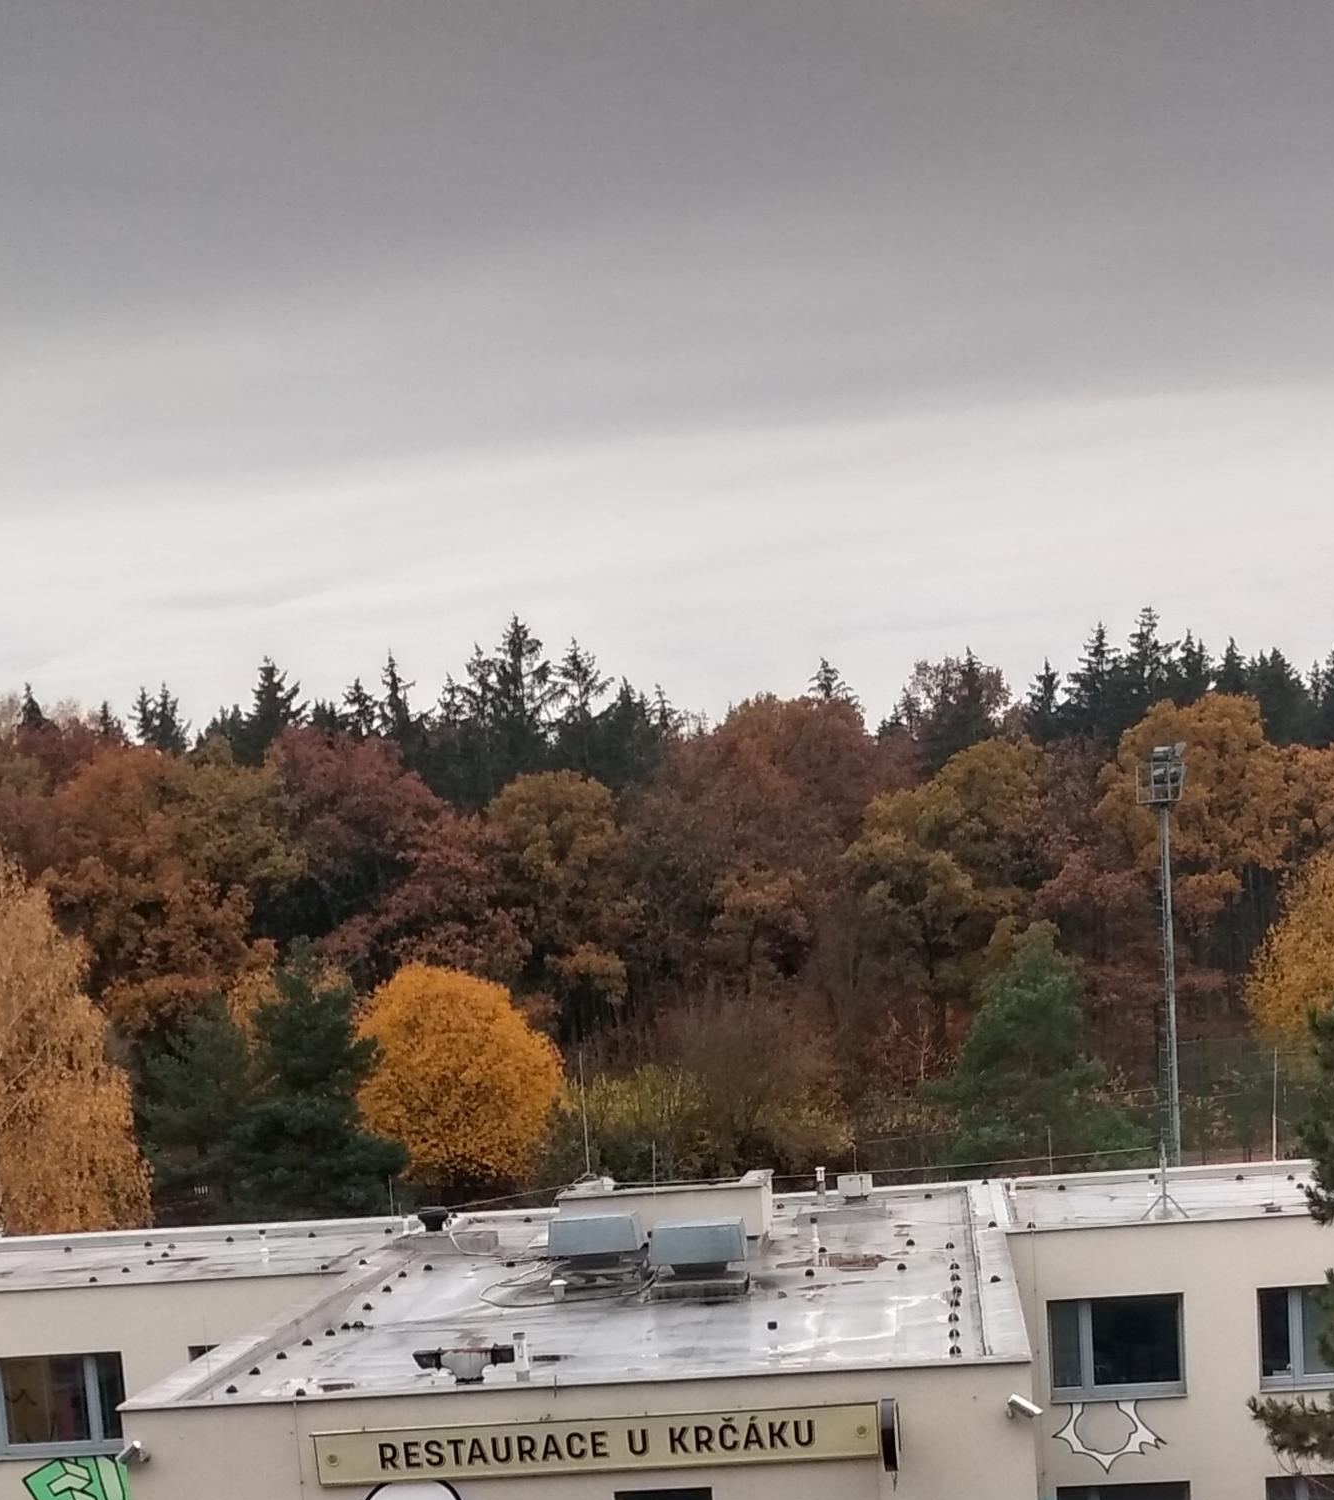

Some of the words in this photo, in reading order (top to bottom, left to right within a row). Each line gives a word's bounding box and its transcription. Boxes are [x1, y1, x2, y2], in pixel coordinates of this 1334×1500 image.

[378, 1430, 610, 1471] RESTAURACE
[627, 1428, 651, 1457] U
[668, 1416, 817, 1454] KRČÁKU
